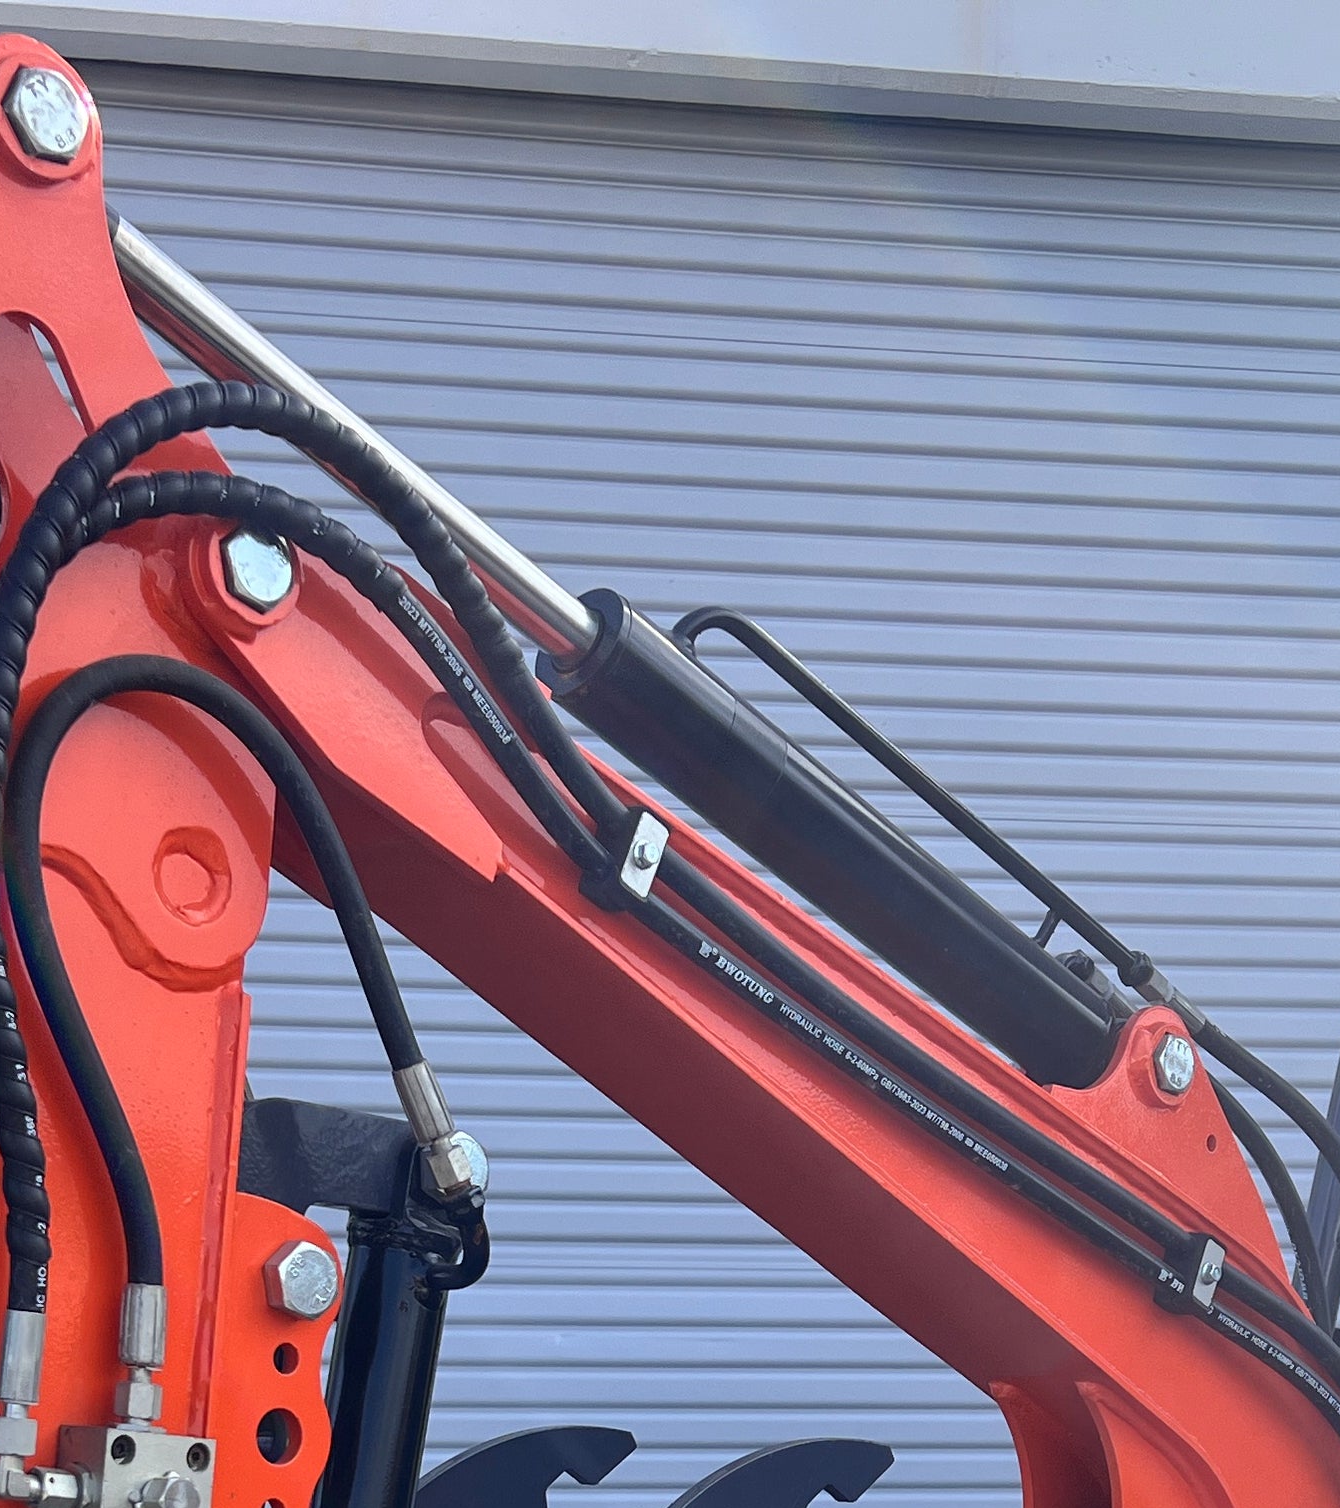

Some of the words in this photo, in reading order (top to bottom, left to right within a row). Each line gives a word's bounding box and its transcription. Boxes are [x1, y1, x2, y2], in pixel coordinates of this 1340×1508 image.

[715, 955, 775, 1004] BWOTUNG
[779, 1003, 823, 1039] HYDRAULIC
[822, 1034, 846, 1055] HOSE
[1217, 1312, 1251, 1339] HYDRAULIC
[1250, 1335, 1268, 1351] HOSE
